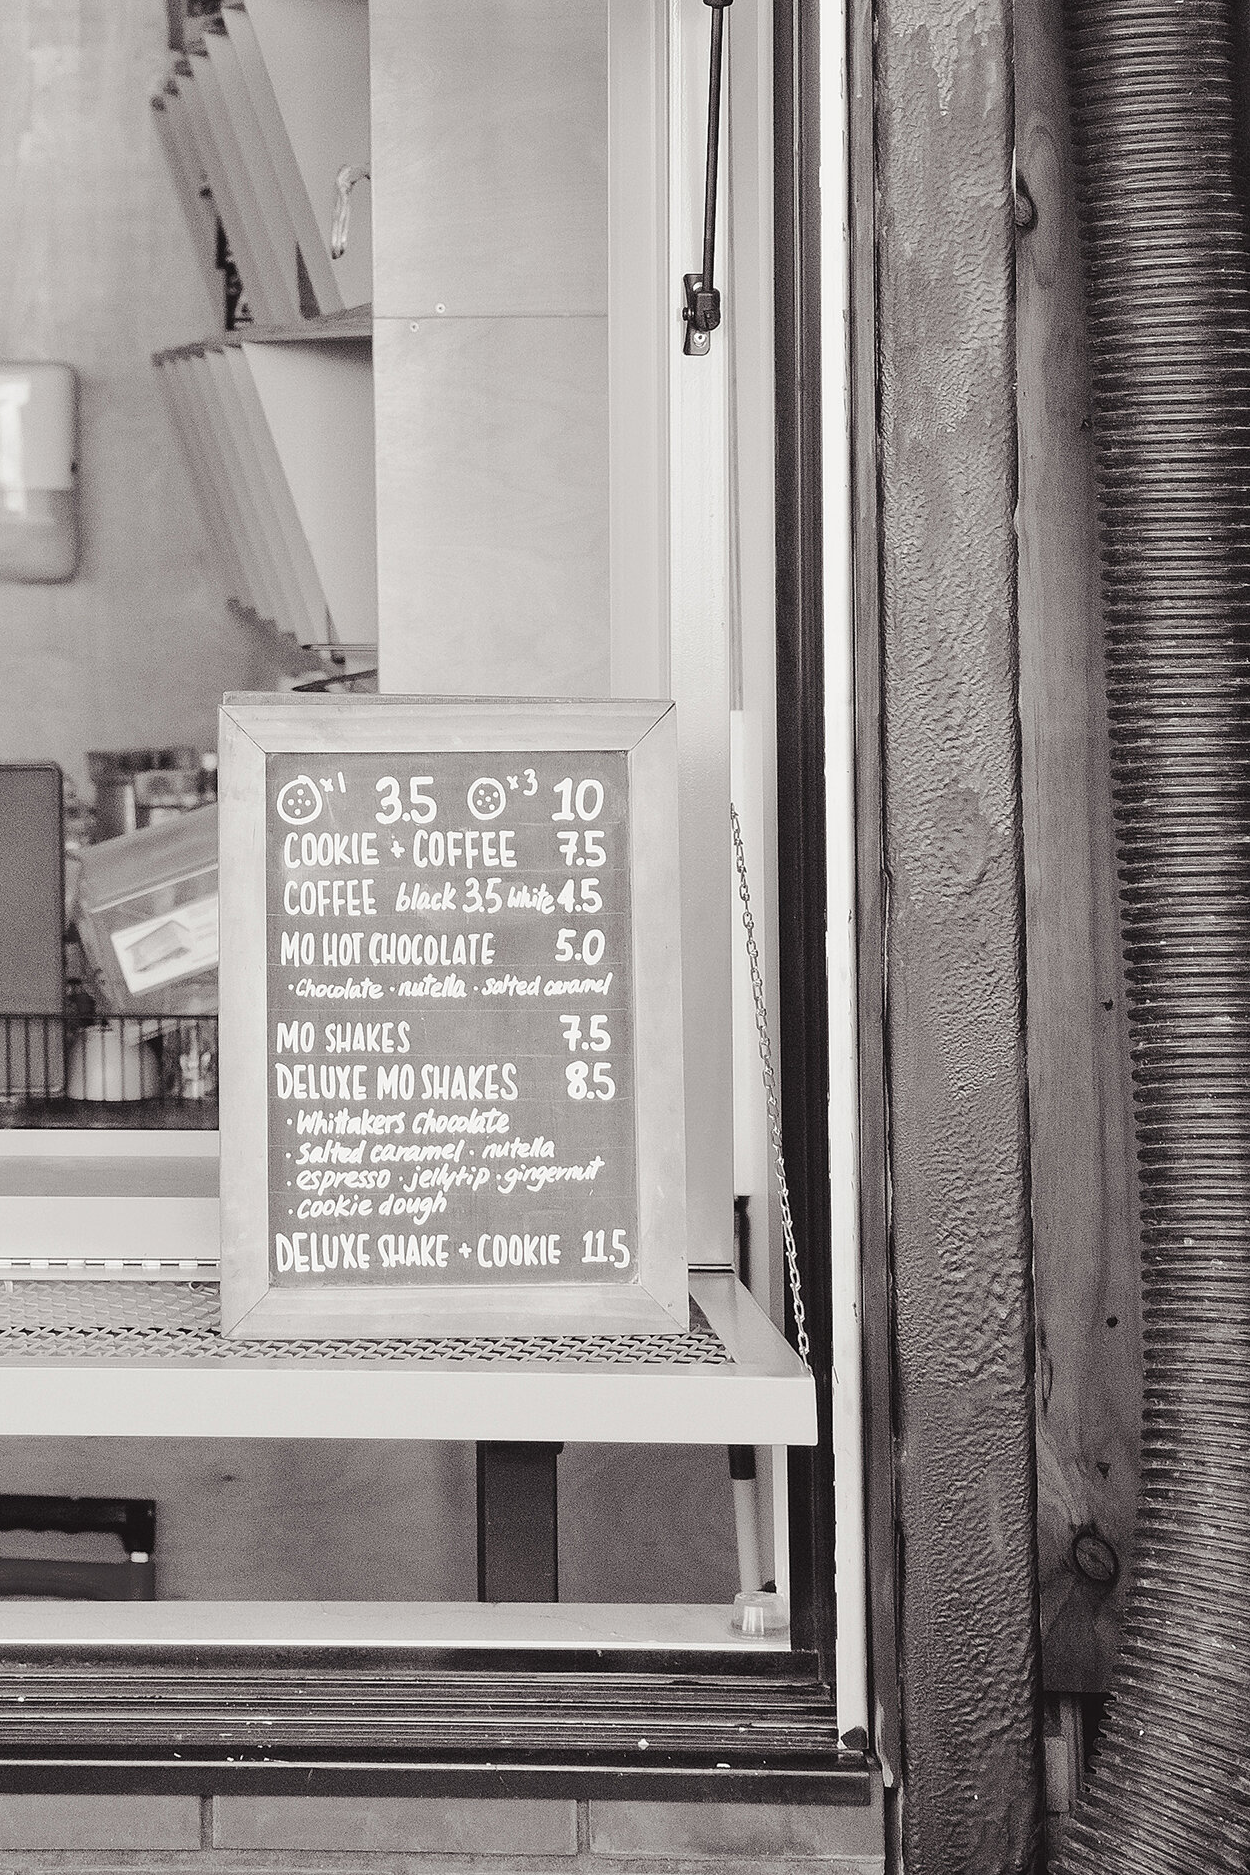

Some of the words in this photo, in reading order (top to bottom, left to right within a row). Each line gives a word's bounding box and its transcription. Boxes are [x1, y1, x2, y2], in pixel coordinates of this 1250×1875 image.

[376, 776, 437, 824] 3.5
[551, 777, 604, 821] 10
[284, 832, 379, 868] COOKIE
[391, 839, 406, 858] +
[413, 829, 517, 868] COFFEE
[557, 831, 607, 867] 7.5
[283, 879, 378, 916] COFFEE
[395, 882, 456, 912] black
[462, 877, 502, 913] 3.5
[557, 877, 603, 913] 4.5
[280, 931, 315, 967] MO
[323, 932, 364, 966] HOT
[368, 932, 496, 966] CHOCOLATE
[554, 928, 605, 965] 5.0
[398, 973, 467, 998] nutella
[543, 972, 613, 996] caramel
[276, 1021, 315, 1054] MO
[324, 1021, 411, 1054] SHAKES
[559, 1015, 611, 1051] 7.5
[275, 1063, 368, 1100] DELUXE
[377, 1064, 415, 1100] MO
[421, 1063, 518, 1100] SHAKES
[564, 1060, 616, 1100] 8.5
[296, 1108, 406, 1135] Whittakers
[370, 1139, 465, 1163] caramel
[481, 1136, 555, 1159] nutella
[296, 1169, 391, 1196] espresso
[403, 1163, 491, 1193] jellytip
[498, 1156, 605, 1194] gingernut
[297, 1194, 373, 1219] cookie
[378, 1191, 447, 1225] dough
[276, 1233, 370, 1273] DELUXE
[377, 1234, 450, 1268] SHAKE
[458, 1242, 473, 1259] +
[477, 1233, 561, 1268] COOKIE
[581, 1229, 631, 1269] 11.5
